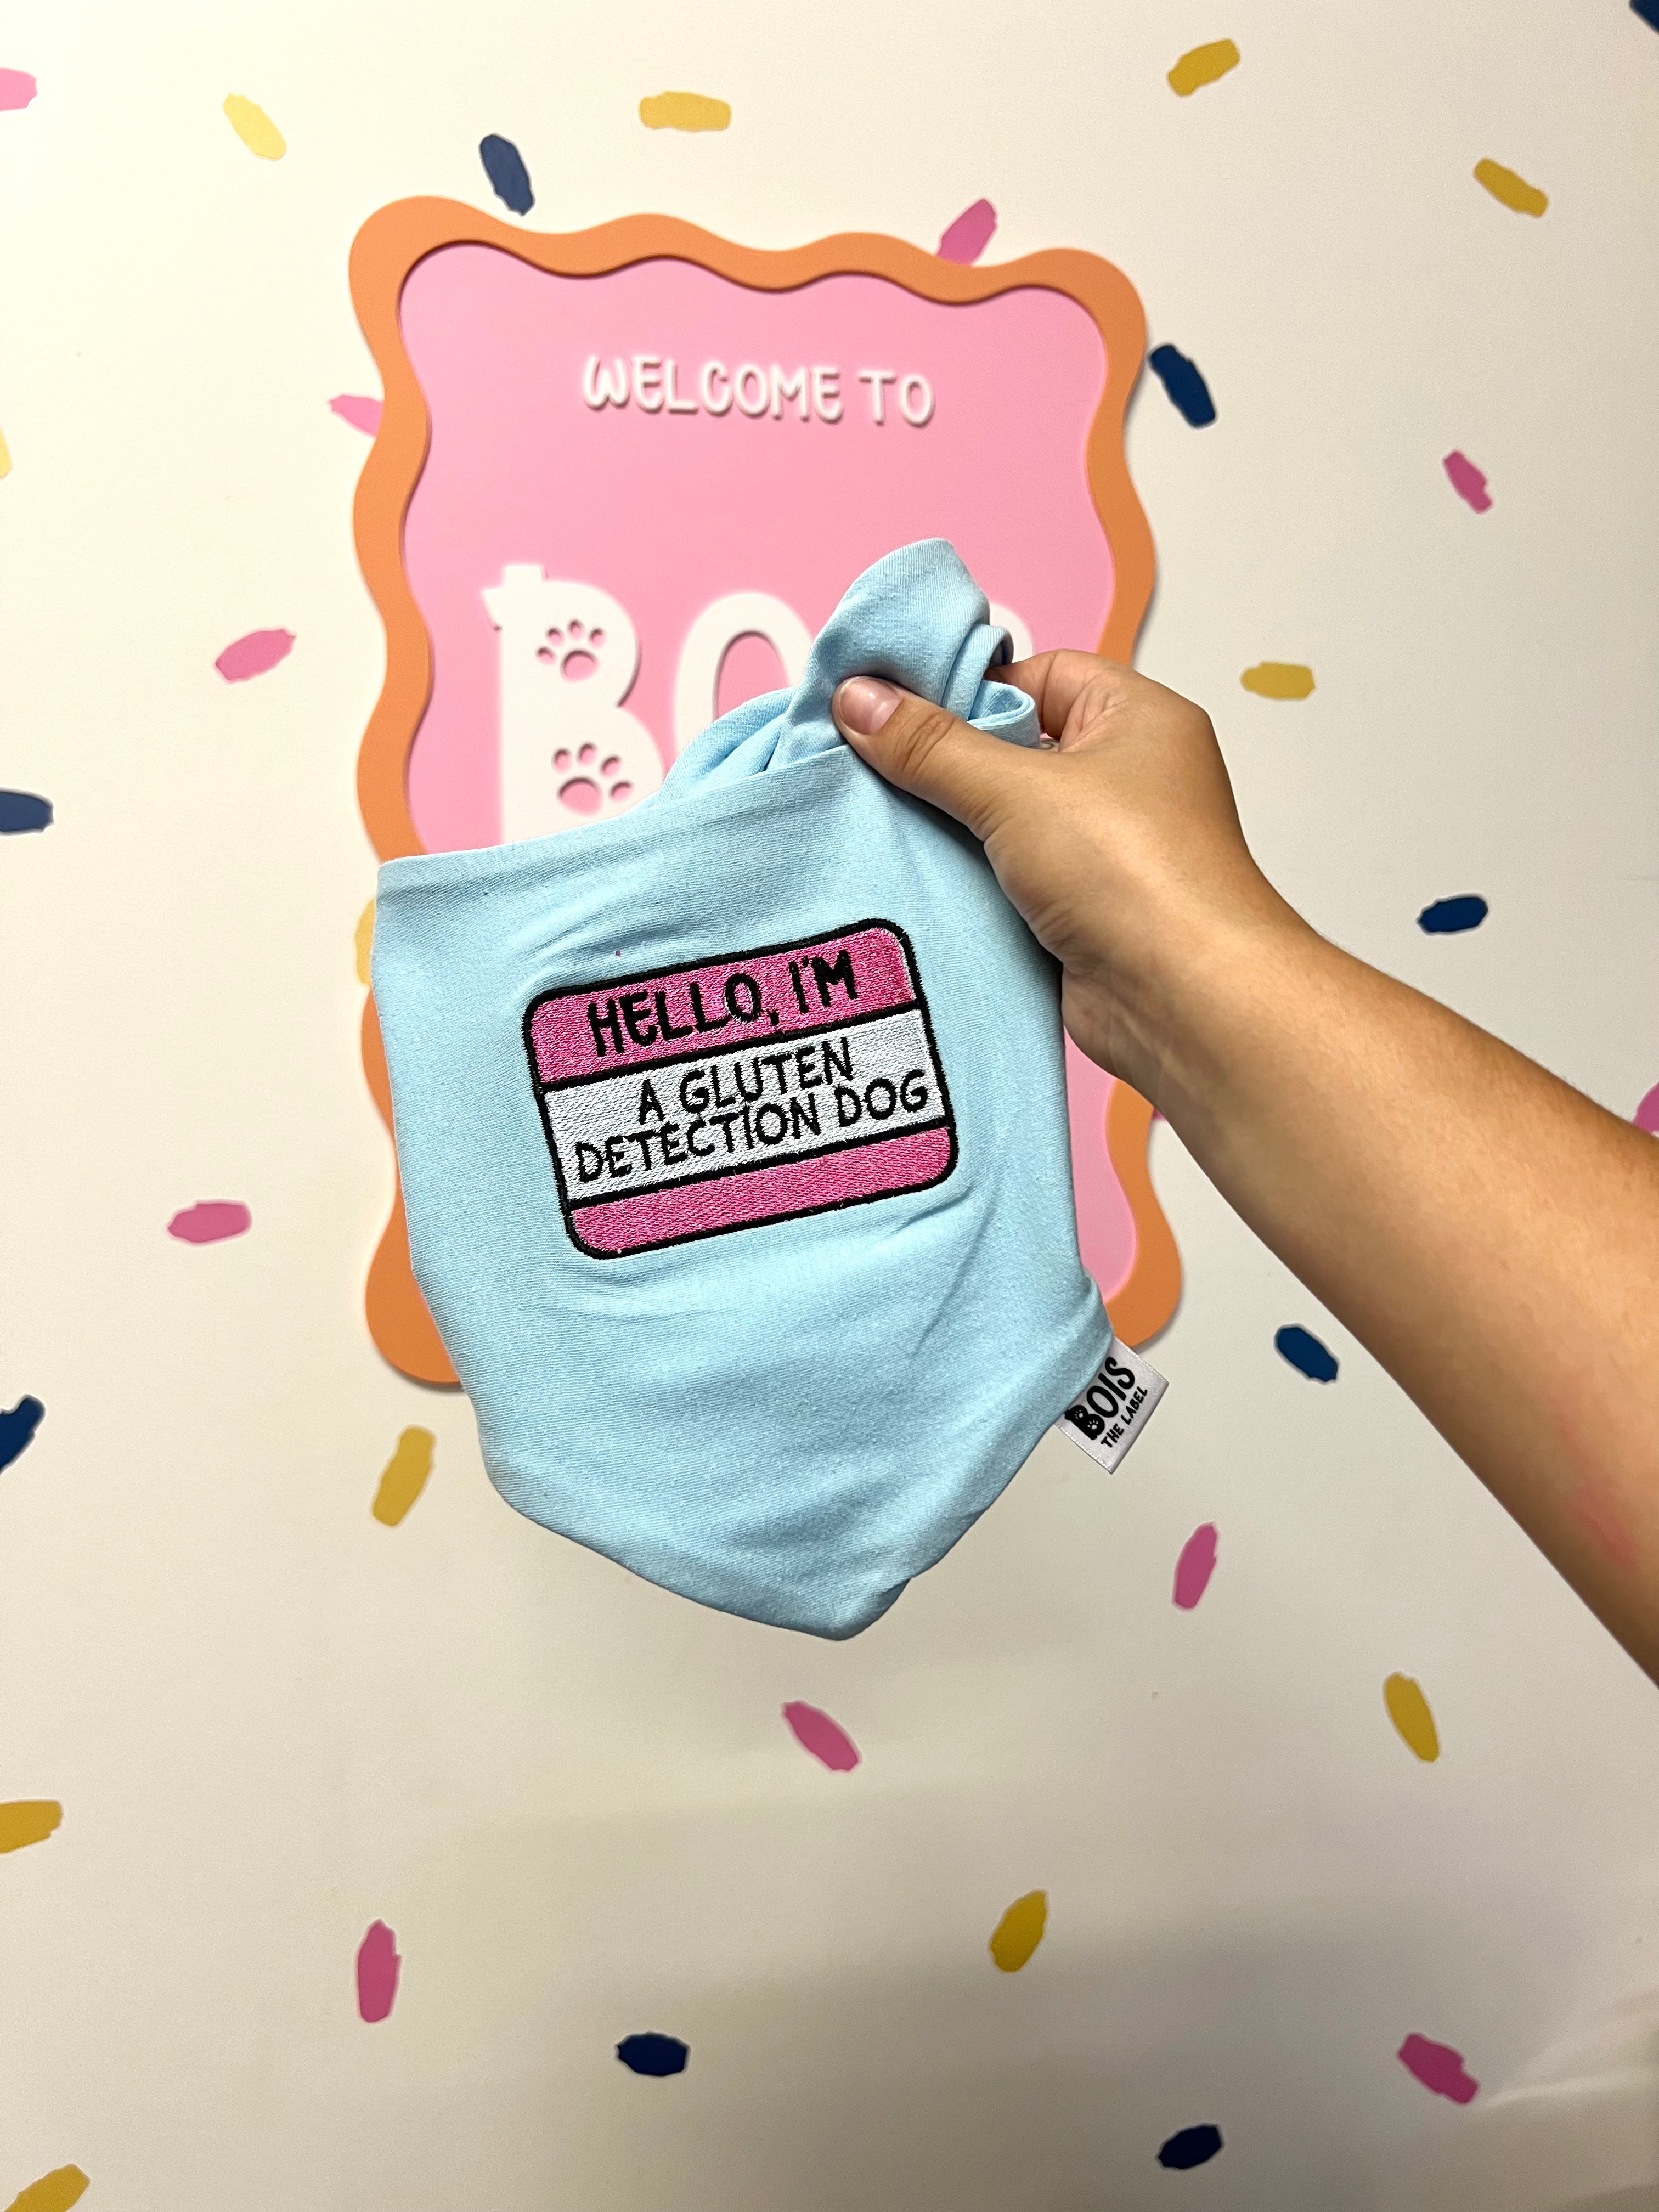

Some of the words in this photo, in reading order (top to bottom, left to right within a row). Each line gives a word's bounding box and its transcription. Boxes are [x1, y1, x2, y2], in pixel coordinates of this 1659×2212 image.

[582, 354, 844, 424] WELCOME
[859, 369, 935, 427] TO
[588, 973, 779, 1057] HELLO,
[789, 949, 857, 1014] I'M
[639, 1079, 665, 1125] A
[680, 1036, 854, 1115] GLUTEN
[576, 1097, 820, 1183] DETECTION
[837, 1069, 928, 1127] DOG
[1064, 1357, 1135, 1440] BOIS
[1101, 1423, 1125, 1448] THE
[1121, 1386, 1148, 1425] LABEL
